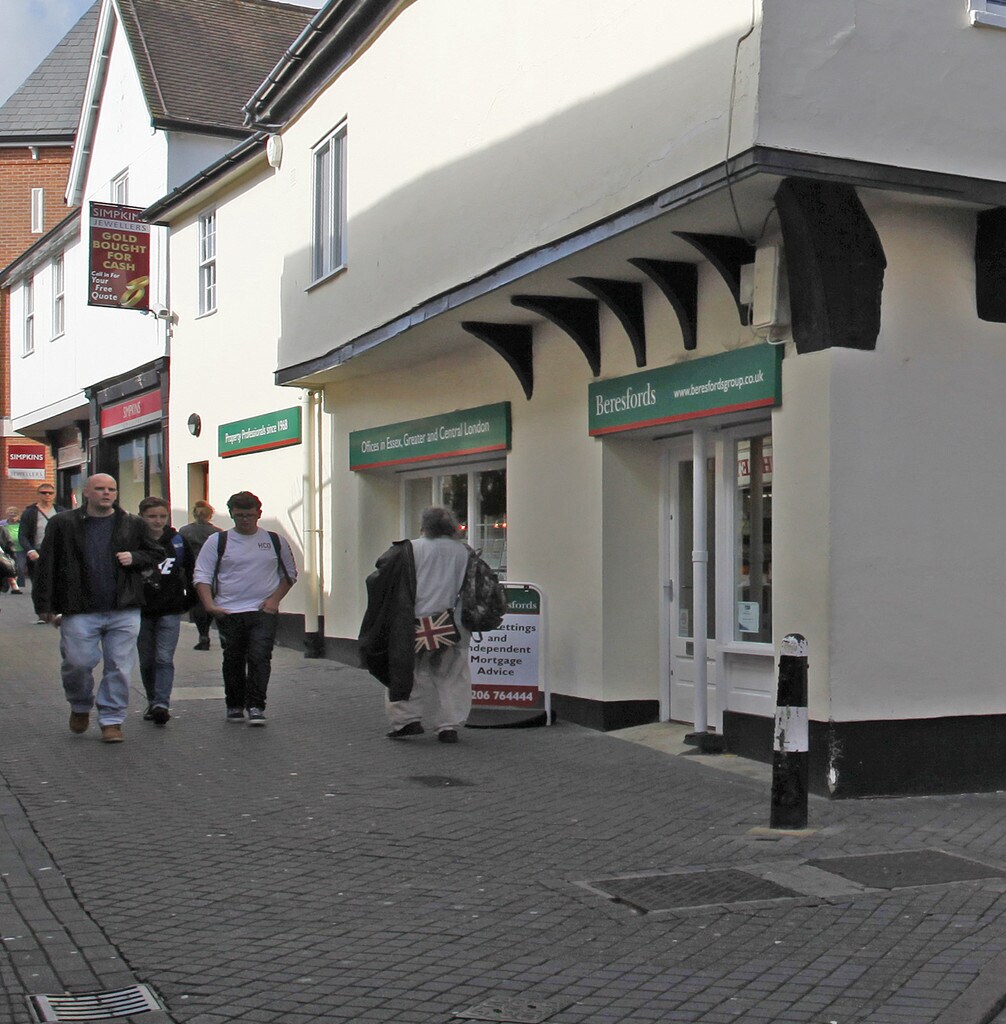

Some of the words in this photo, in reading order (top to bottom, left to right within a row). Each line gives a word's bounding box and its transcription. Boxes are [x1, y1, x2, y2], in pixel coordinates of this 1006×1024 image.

[93, 219, 147, 232] JEWELLERS
[102, 232, 137, 243] GOLD
[92, 240, 146, 254] BOUGHT
[107, 251, 131, 262] FOR
[103, 261, 135, 271] CASH
[91, 276, 109, 284] Your
[95, 284, 113, 293] Free
[91, 291, 118, 301] Quote
[595, 383, 657, 416] Beresfords
[673, 370, 764, 398] www.beresfordsgroup.co.uk
[123, 401, 141, 419] SIMPKINS
[242, 425, 266, 439] Professionals
[266, 423, 277, 435] since
[361, 440, 379, 453] Offices
[380, 440, 386, 450] in
[386, 437, 402, 450] Essex,
[403, 432, 426, 447] Greater
[427, 428, 438, 442] and
[439, 424, 463, 440] Central
[464, 420, 489, 436] London
[10, 453, 43, 461] SIMPKINS
[507, 600, 537, 609] sfords
[500, 624, 536, 634] ettings
[469, 645, 531, 654] ndependent
[471, 655, 522, 666] Mortgage
[477, 667, 515, 676] Advice
[472, 690, 490, 700] 206
[493, 691, 533, 701] 764444
